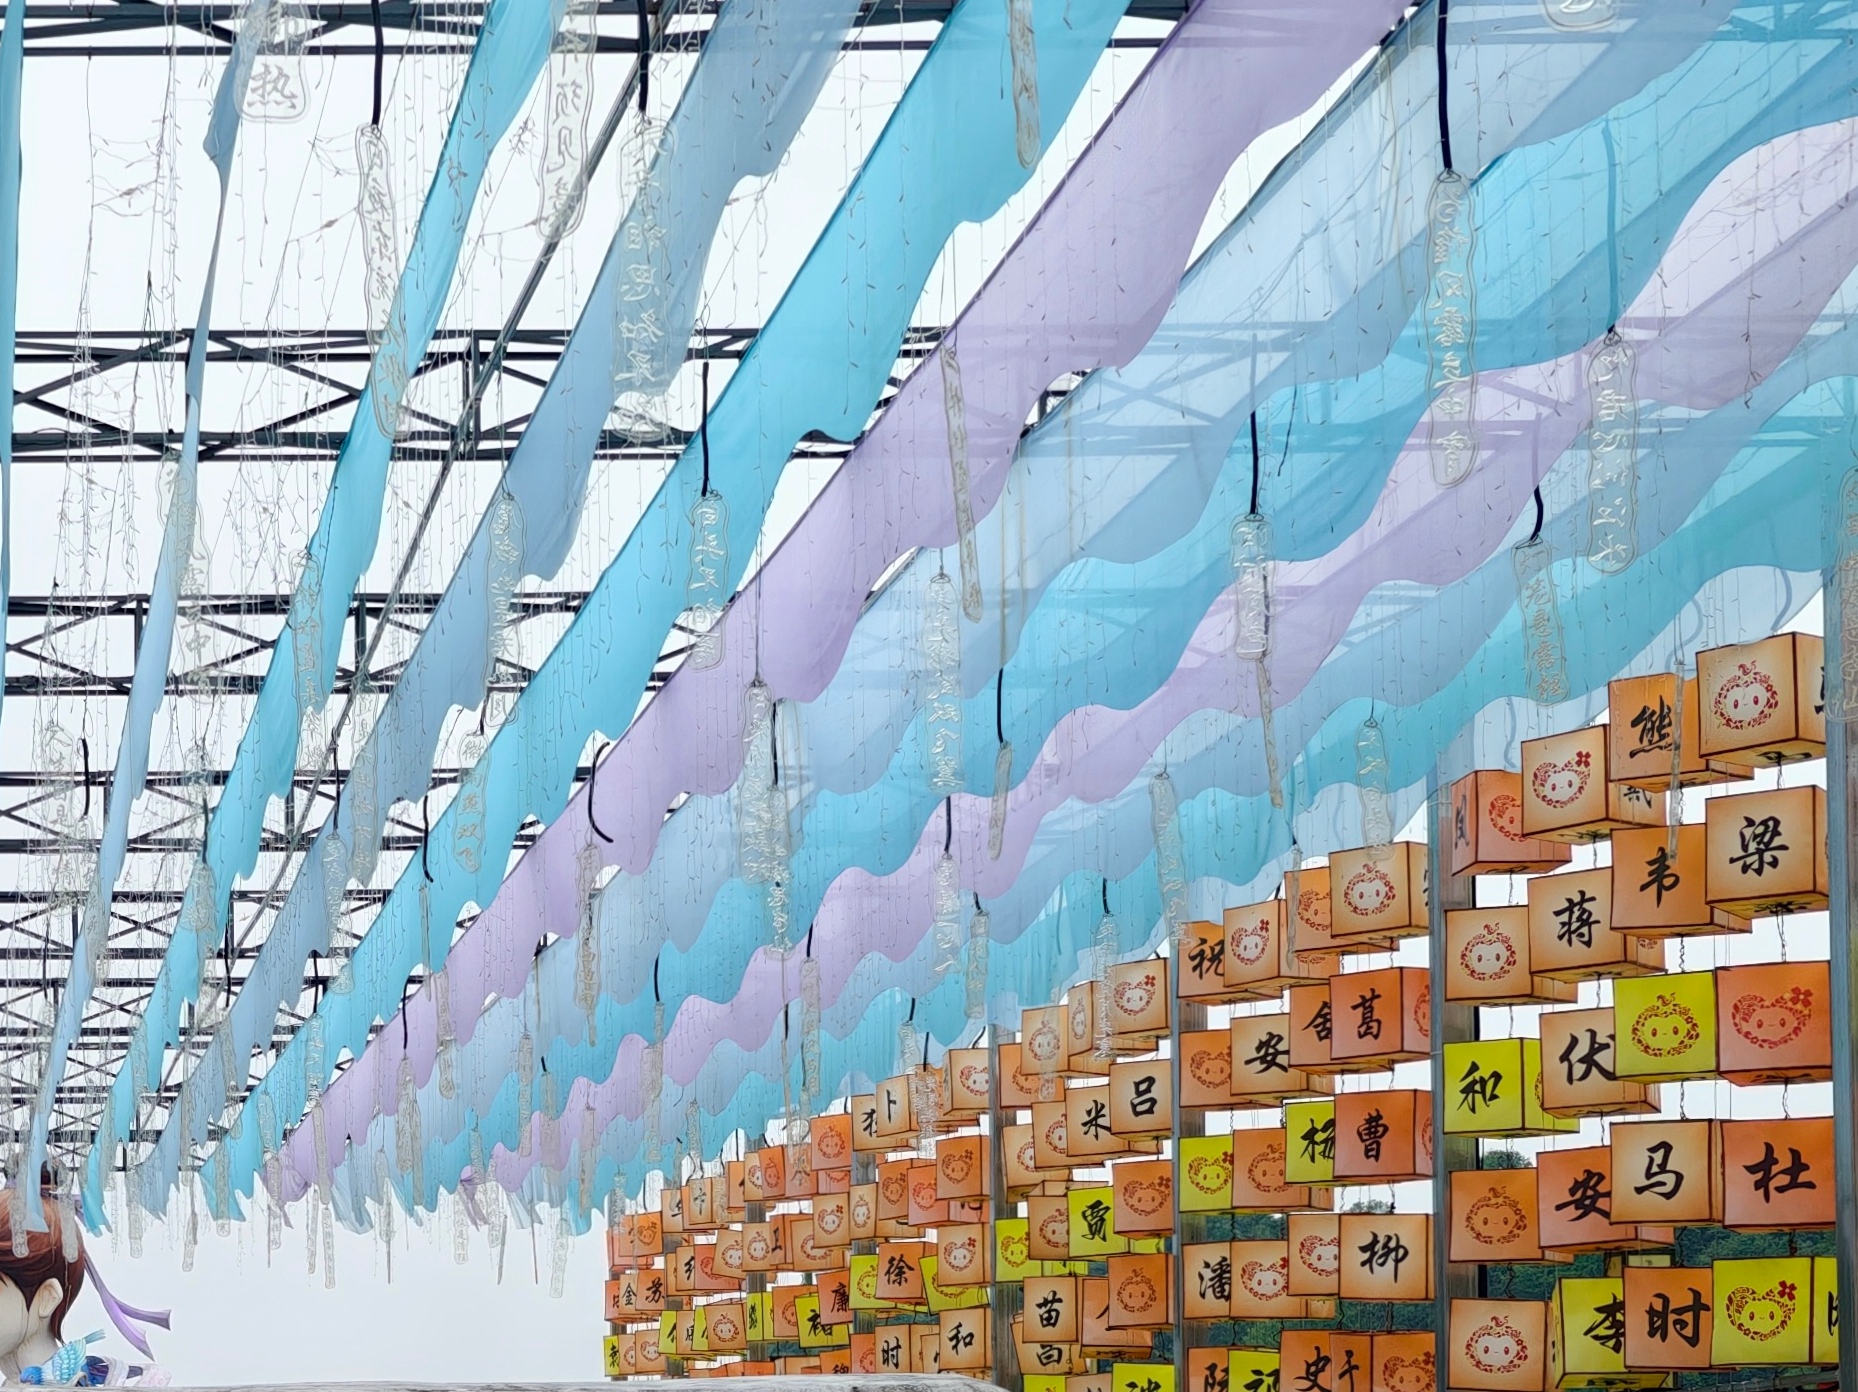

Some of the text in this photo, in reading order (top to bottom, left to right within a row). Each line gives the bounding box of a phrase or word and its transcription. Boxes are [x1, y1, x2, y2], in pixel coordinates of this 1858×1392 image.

[1629, 695, 1679, 759] 熊
[1729, 816, 1789, 877] 梁
[1639, 847, 1680, 908] 韦
[1553, 890, 1601, 949] 蒋
[1350, 988, 1383, 1041] 葛
[1244, 1032, 1290, 1075] 安
[1558, 1028, 1616, 1086] 伏
[1130, 1076, 1158, 1118] 吕
[1457, 1061, 1503, 1115] 和
[1081, 1100, 1112, 1141] 米
[1356, 1108, 1390, 1164] 曹
[1555, 1169, 1611, 1222] 安
[1634, 1141, 1685, 1200] 马
[1742, 1142, 1817, 1203] 杜
[884, 1254, 915, 1287] 徐
[1198, 1256, 1231, 1302] 潘
[1358, 1231, 1409, 1284] 柳
[622, 1283, 637, 1306] 金
[645, 1277, 665, 1303] 苏
[1036, 1290, 1063, 1329] 苗
[947, 1322, 975, 1356] 和
[1645, 1288, 1712, 1349] 时
[881, 1336, 902, 1369] 时
